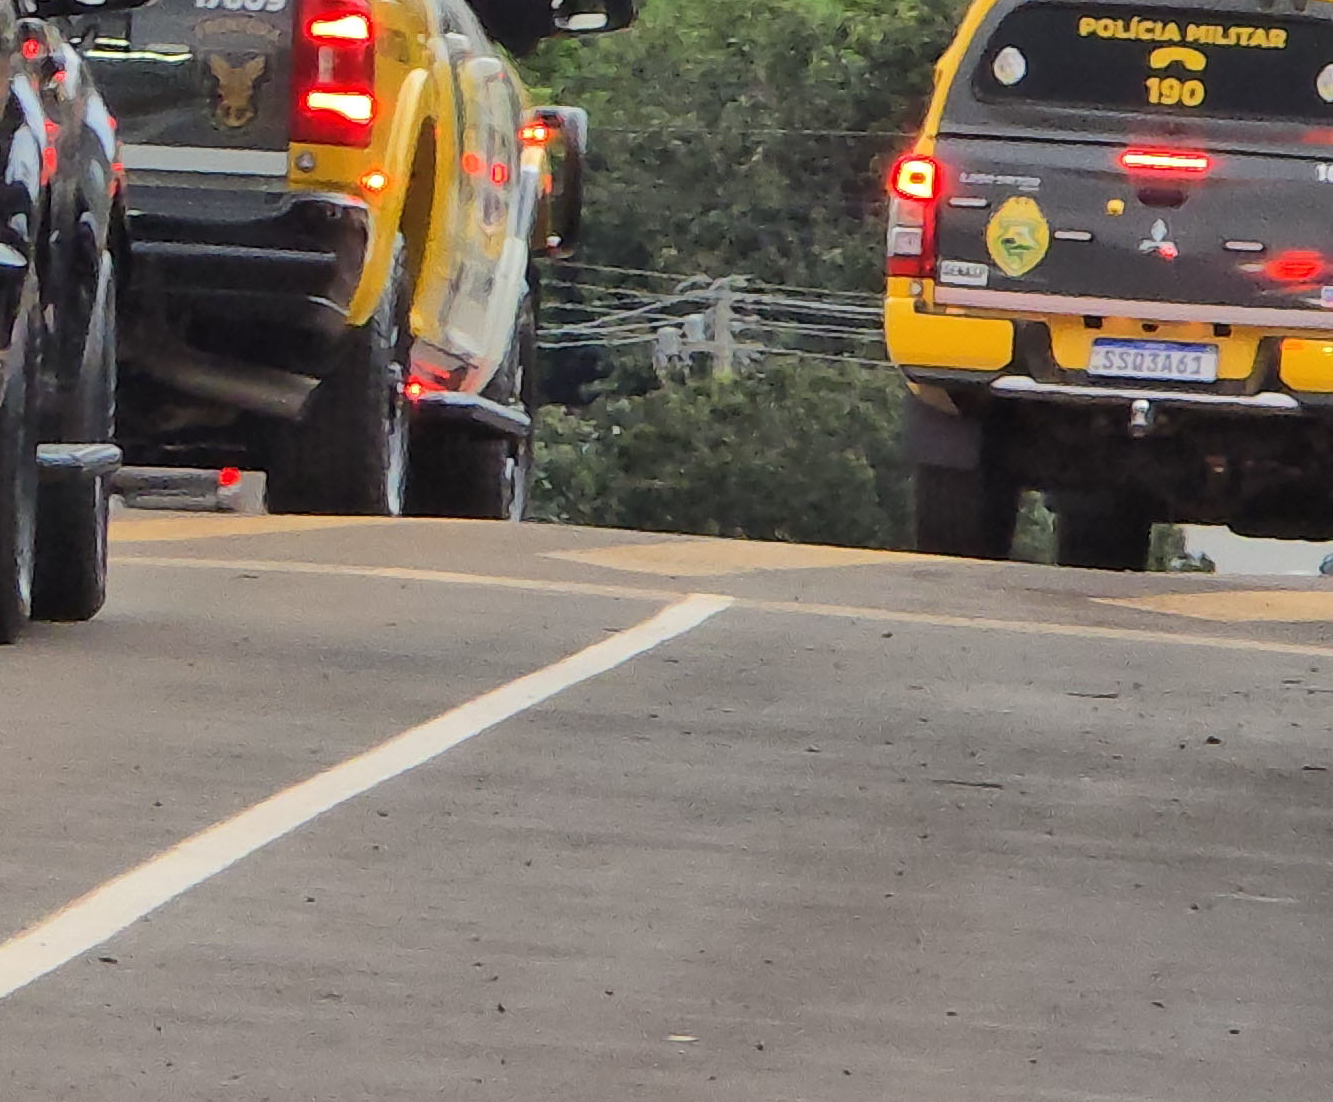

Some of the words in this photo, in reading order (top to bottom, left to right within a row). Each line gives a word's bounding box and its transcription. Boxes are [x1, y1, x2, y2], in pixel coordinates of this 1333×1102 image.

[1078, 16, 1182, 42] POLÍCIA
[1186, 24, 1287, 48] MILITAR
[1146, 77, 1204, 106] 190
